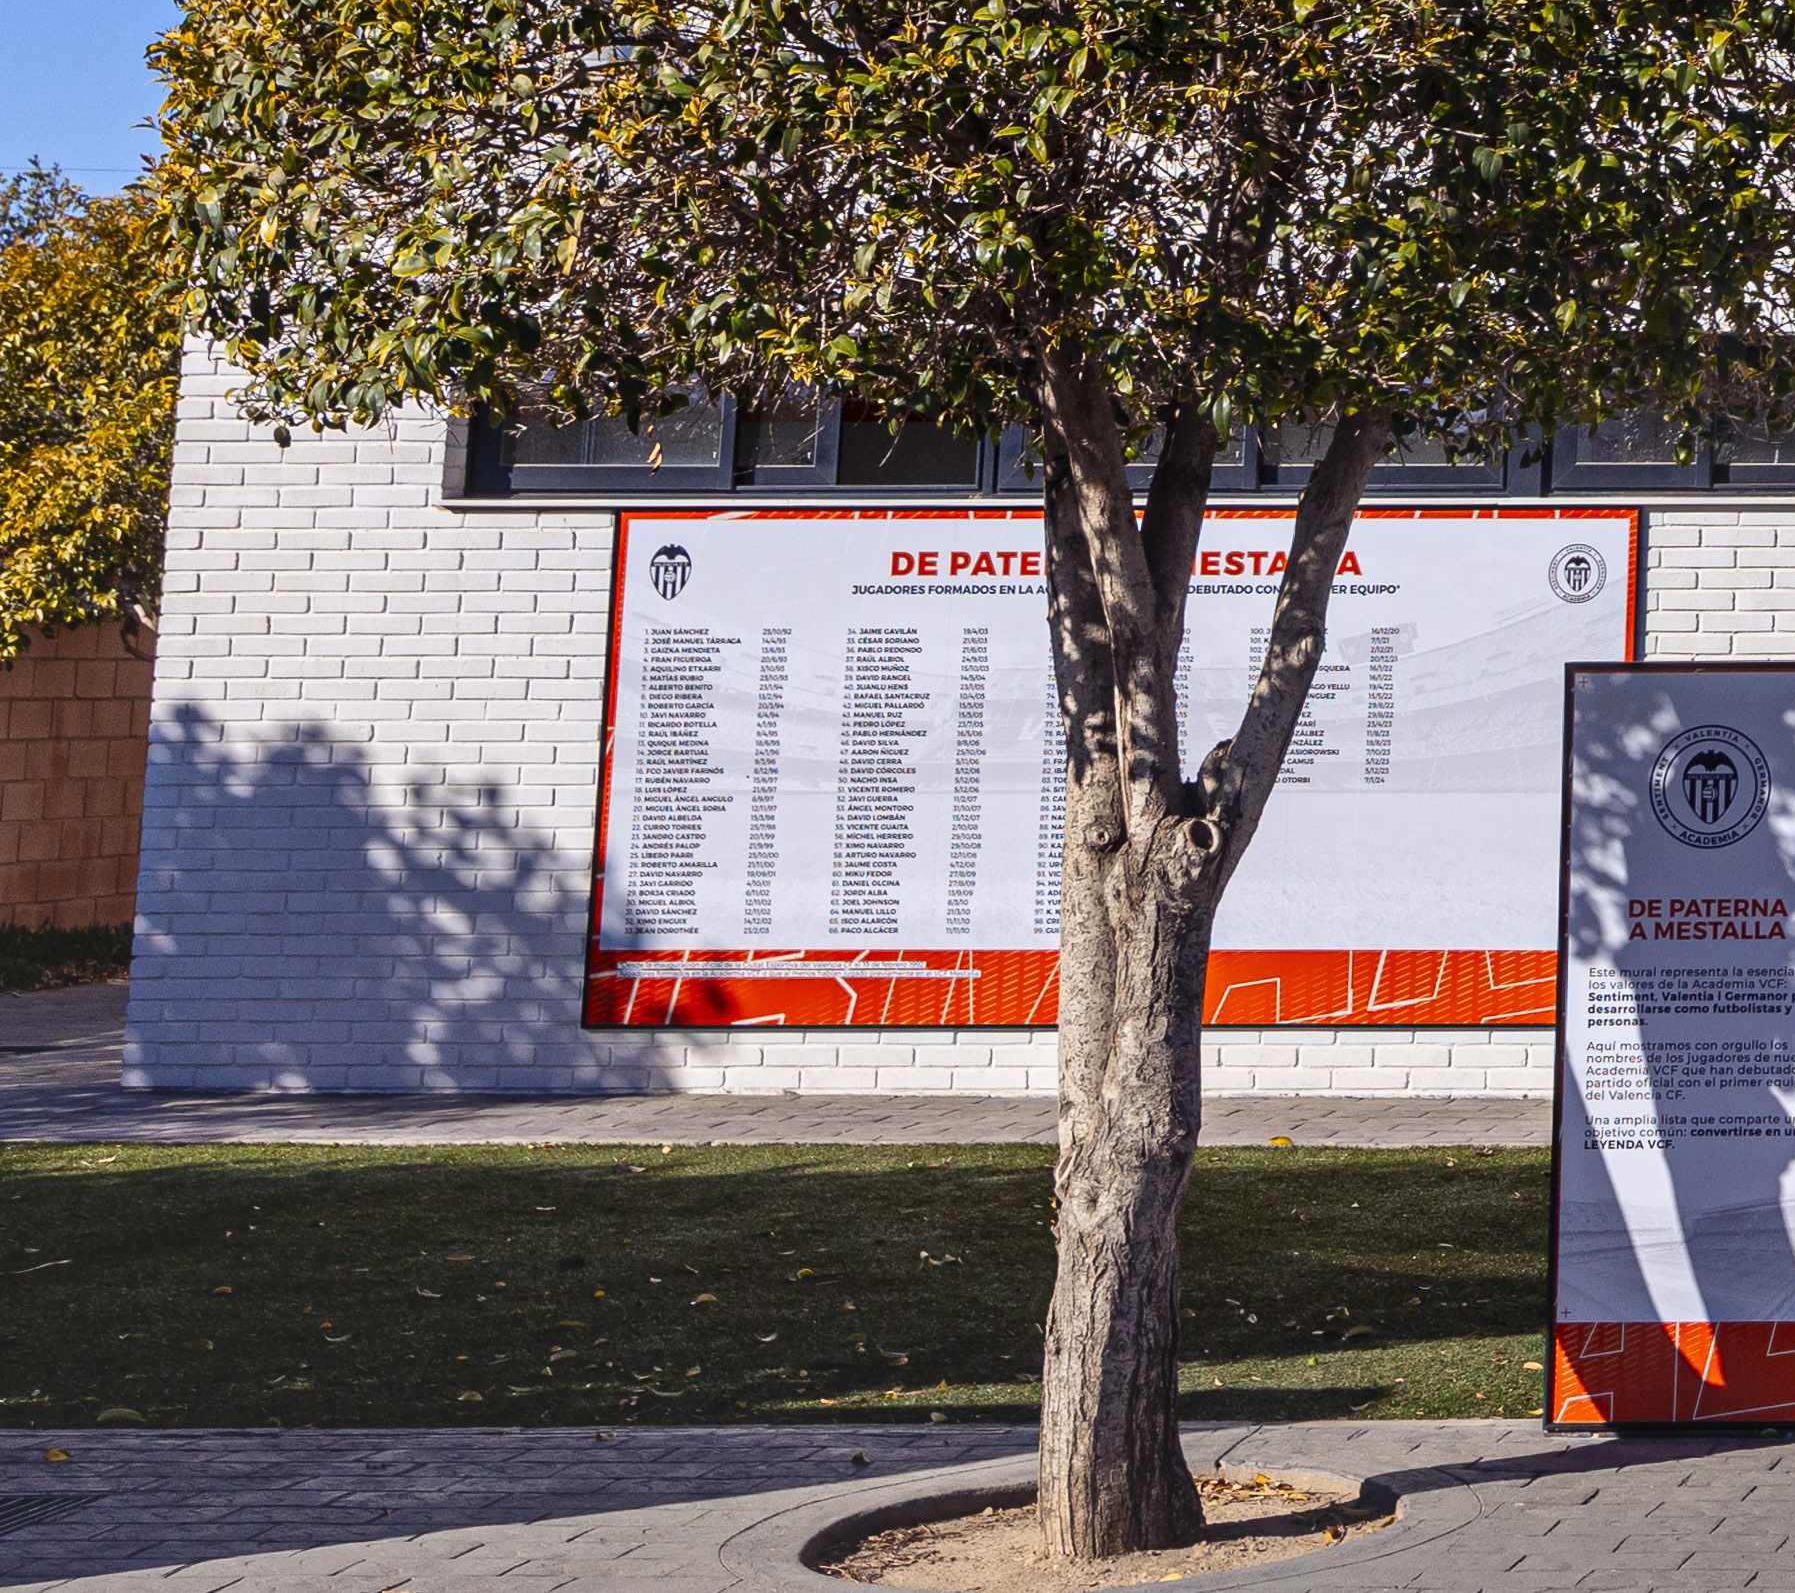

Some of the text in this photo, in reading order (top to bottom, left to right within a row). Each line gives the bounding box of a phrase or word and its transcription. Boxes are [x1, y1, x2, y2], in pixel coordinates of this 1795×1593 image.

[890, 551, 939, 576] DE
[948, 551, 1047, 576] PATE
[852, 585, 925, 594] JUGADORES
[928, 585, 996, 594] FORMADOS
[1000, 585, 1016, 594] EN
[1019, 585, 1033, 594] LA
[1187, 584, 1253, 595] DEBUTADO
[1255, 584, 1281, 595] CON
[851, 739, 900, 747] DAVID SILVA
[1684, 730, 1739, 743] VALENTIA
[1654, 756, 1669, 820] SENTIMENT
[1750, 757, 1768, 820] GERMANOR
[1679, 830, 1740, 845] ACADEMIA
[1629, 899, 1788, 918] DE PATERNA
[1629, 921, 1786, 940] A MESTALLA
[1589, 968, 1615, 977] Este
[1620, 967, 1656, 978] mural
[1660, 968, 1728, 980] representa
[1733, 966, 1743, 977] la
[1745, 966, 1794, 978] esencia
[1589, 979, 1787, 990] los valores de la Academia VCF:
[1662, 990, 1714, 1001] Valentia
[1723, 990, 1788, 1004] Germanor
[1674, 1006, 1709, 1014] como
[1713, 1003, 1782, 1013] futbolistas
[1784, 1005, 1792, 1015] y
[1588, 1019, 1648, 1028] personas.
[1587, 1040, 1788, 1053] Aquí mostramos con orgullo los
[1587, 1052, 1643, 1063] nombres
[1647, 1053, 1662, 1063] de
[1663, 1052, 1684, 1063] los
[1685, 1052, 1750, 1066] jugadores
[1752, 1052, 1770, 1063] de
[1586, 1065, 1651, 1075] Academia
[1653, 1065, 1678, 1075] VCF
[1682, 1067, 1706, 1077] que
[1710, 1065, 1736, 1075] han
[1586, 1078, 1632, 1090] partido
[1678, 1079, 1703, 1088] con
[1705, 1077, 1716, 1087] el
[1720, 1077, 1762, 1089] primer
[1585, 1090, 1685, 1100] del Valencia CF.
[1586, 1116, 1609, 1125] Una
[1614, 1115, 1656, 1126] amplia
[1659, 1115, 1687, 1125] lista
[1691, 1117, 1715, 1126] que
[1719, 1115, 1780, 1127] comparte
[1585, 1127, 1635, 1139] objetivo
[1690, 1126, 1762, 1136] convertirse
[1585, 1140, 1674, 1149] LEYENDA VCF.
